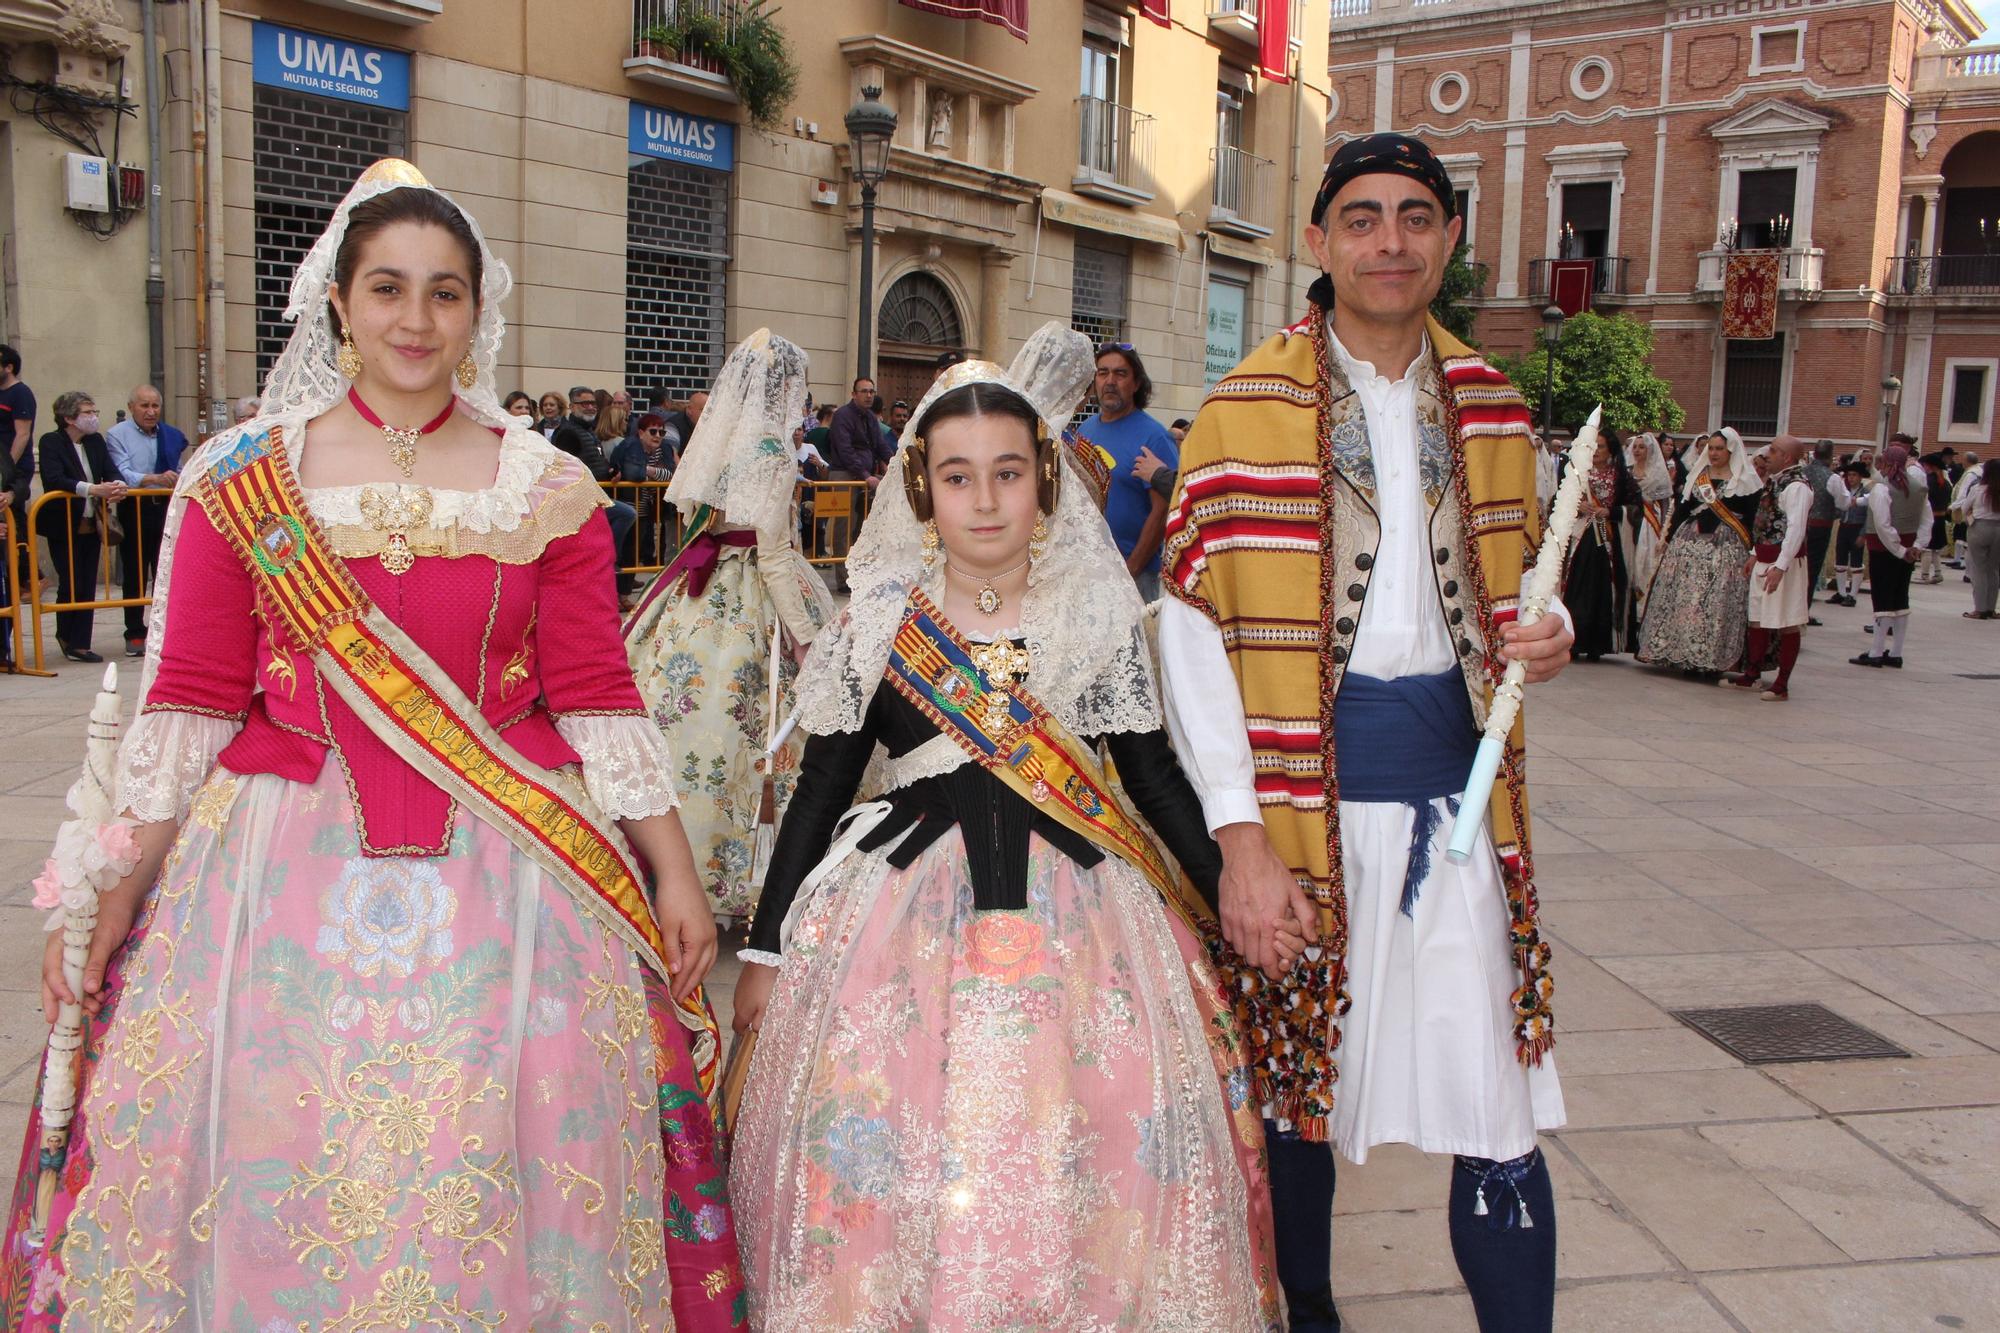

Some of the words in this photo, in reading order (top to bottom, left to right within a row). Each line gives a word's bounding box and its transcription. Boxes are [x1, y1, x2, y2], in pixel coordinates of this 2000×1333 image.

[278, 32, 383, 85] UMAS
[283, 72, 319, 88] MUTUA
[321, 79, 334, 91] DE
[335, 82, 379, 99] SEGUROS
[645, 110, 716, 151] UMAS
[647, 142, 672, 153] MUTUA
[673, 147, 682, 156] DE
[683, 149, 713, 162] SEGUROS
[1205, 344, 1228, 358] Oficina
[1229, 347, 1236, 359] de
[237, 487, 275, 526] 2020
[291, 572, 328, 610] 2021
[902, 635, 939, 676] 2022
[389, 688, 530, 807] FALLERA
[523, 800, 625, 890] MAJOR
